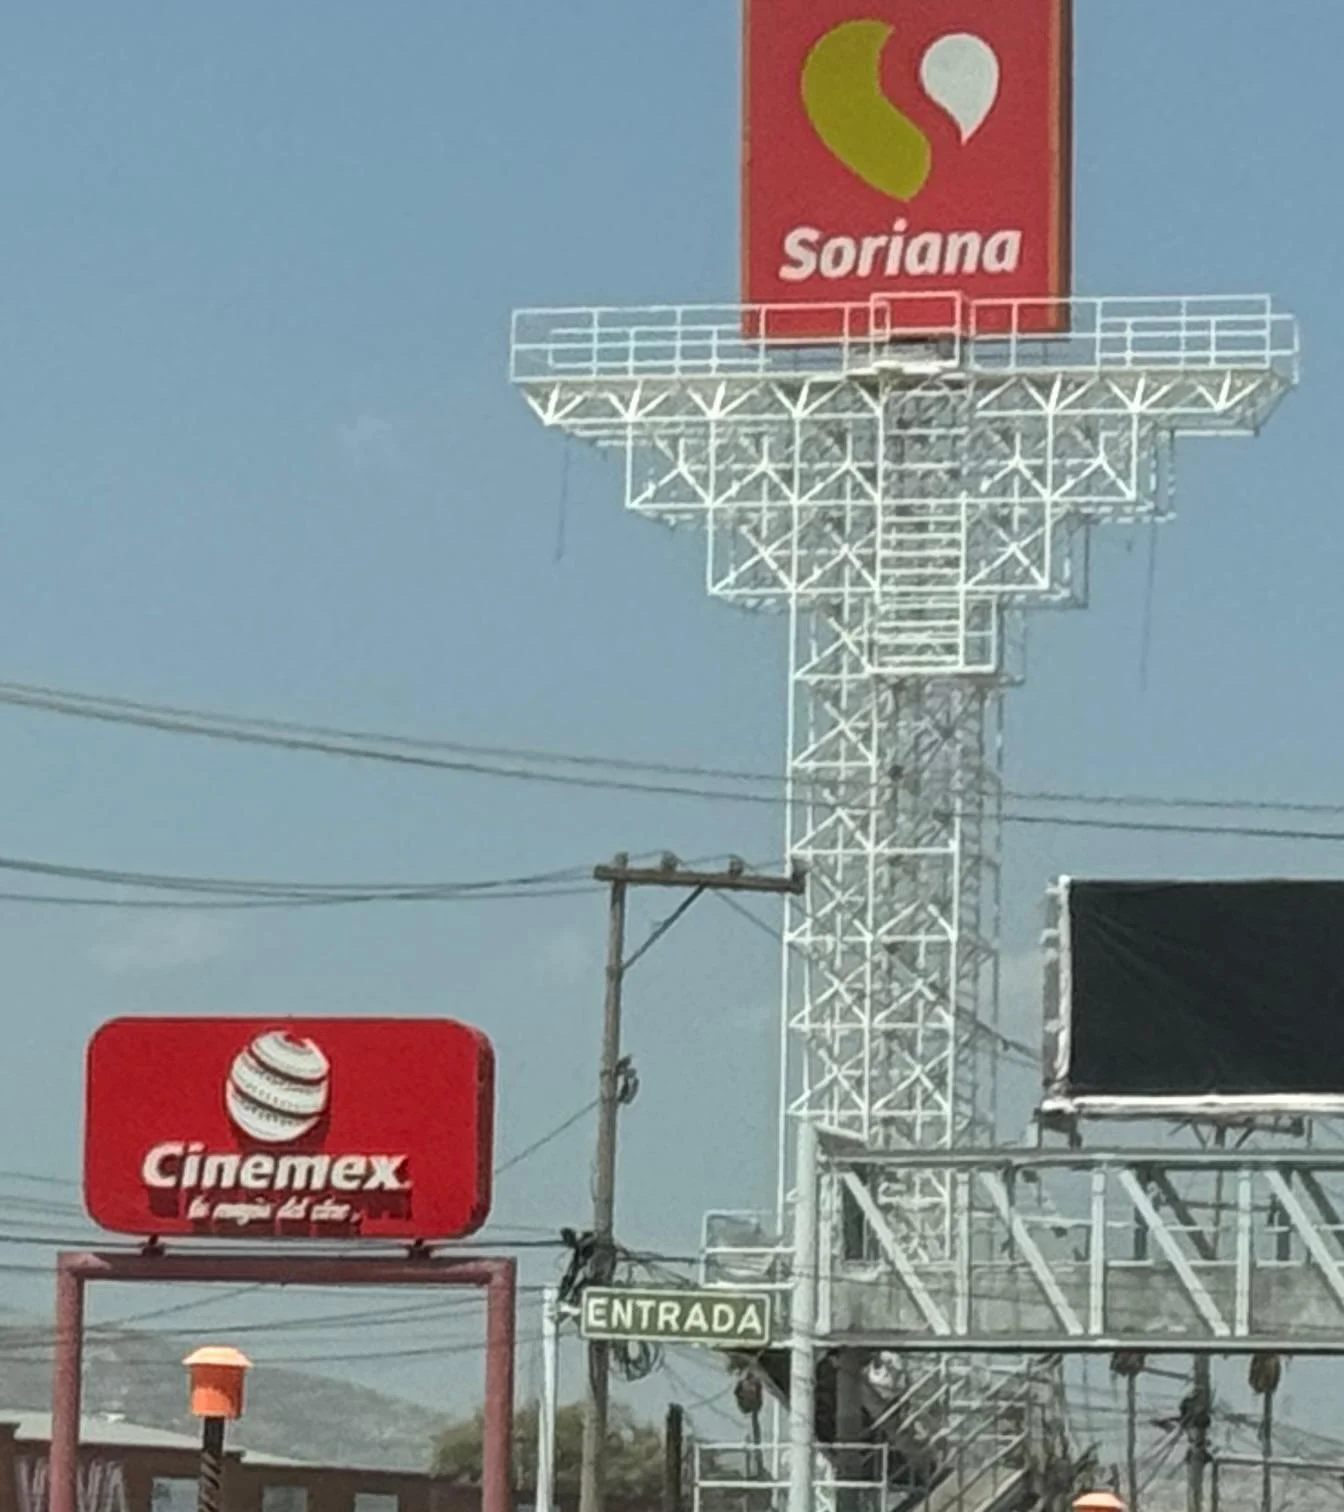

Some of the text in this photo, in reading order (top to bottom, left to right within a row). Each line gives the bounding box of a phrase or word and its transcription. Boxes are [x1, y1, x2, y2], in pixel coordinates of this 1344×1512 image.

[778, 217, 1023, 282] Soriana
[142, 1140, 407, 1190] Cinemex
[587, 1297, 763, 1335] ENTRADA
